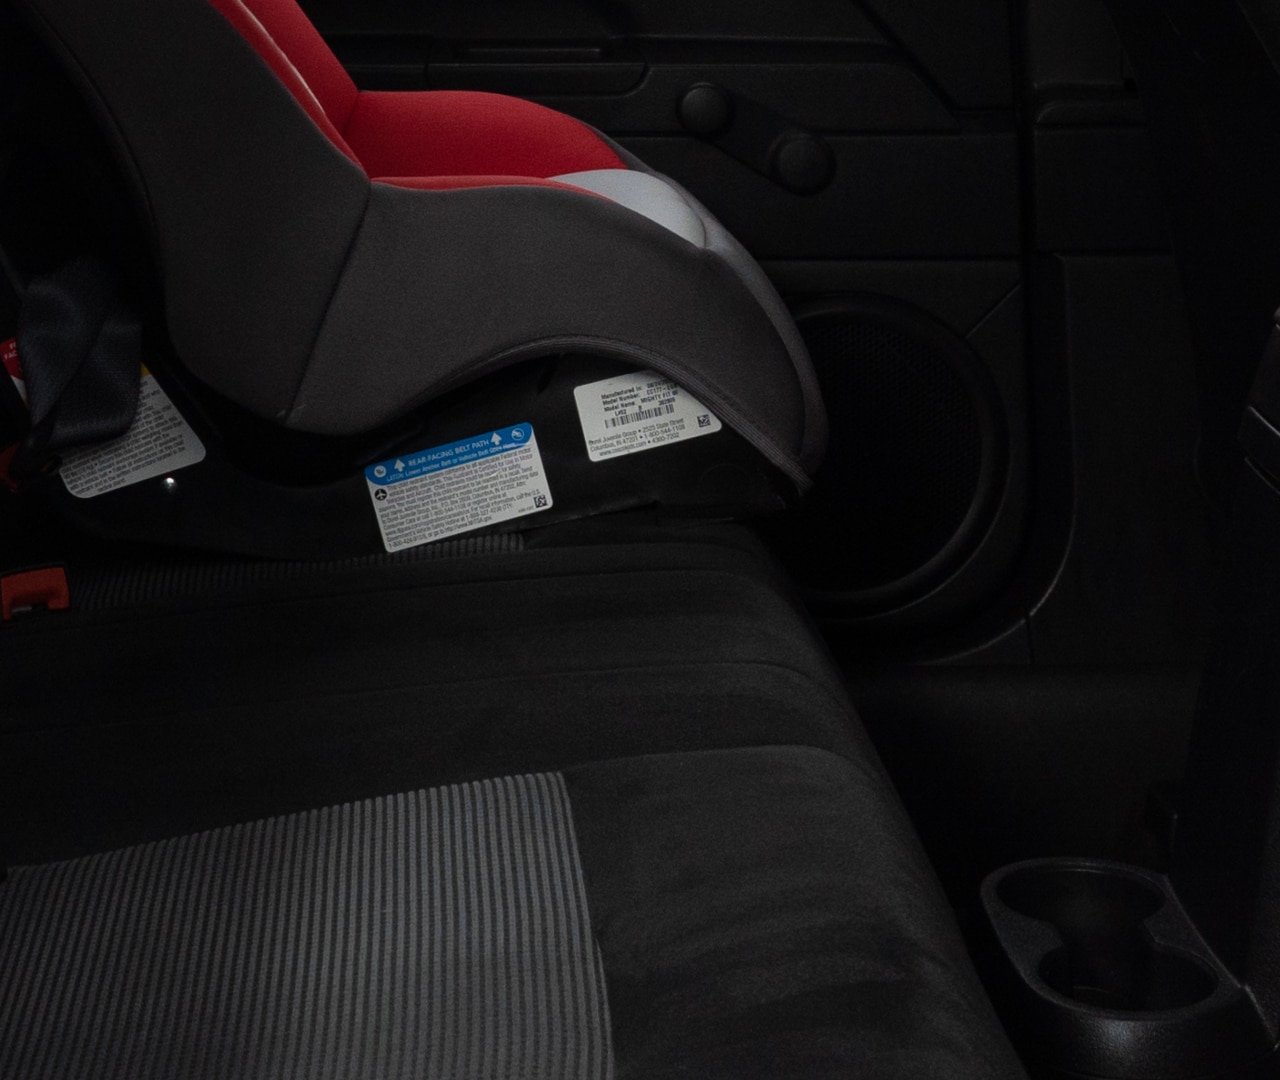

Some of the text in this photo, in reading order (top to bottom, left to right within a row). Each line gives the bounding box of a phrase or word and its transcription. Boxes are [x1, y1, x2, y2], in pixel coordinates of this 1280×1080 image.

[407, 438, 490, 467] REAR-FACING BELT PATH
